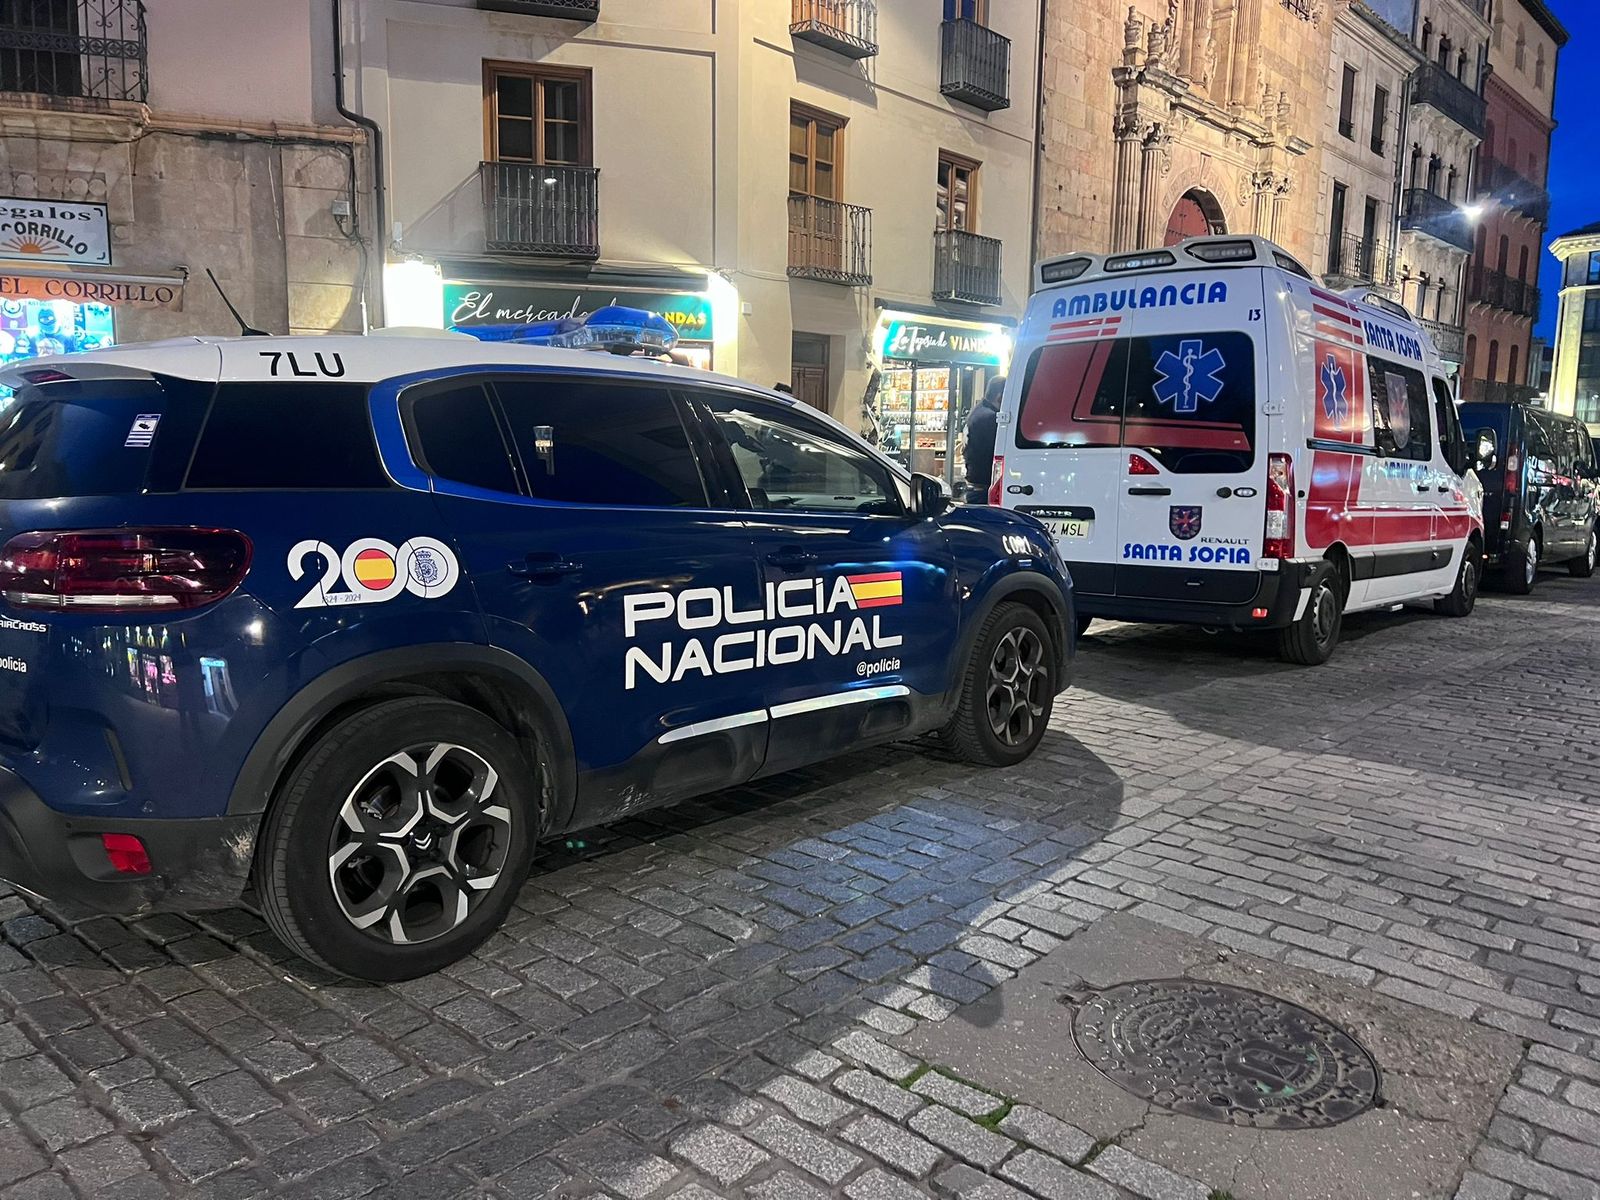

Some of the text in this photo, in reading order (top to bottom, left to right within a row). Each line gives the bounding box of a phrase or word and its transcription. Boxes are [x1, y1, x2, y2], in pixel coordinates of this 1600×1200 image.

[45, 279, 174, 303] CORRILLO
[1052, 281, 1227, 318] AMBULANCIA
[451, 291, 493, 323] El
[1248, 309, 1261, 321] 13
[1363, 320, 1423, 362] SANTA SOFIA
[259, 352, 346, 378] 7LU
[1060, 523, 1084, 537] MSL
[1200, 536, 1250, 545] RENAULT
[1123, 543, 1251, 564] SANTA SOFIA
[624, 614, 903, 690] NACIONAL
